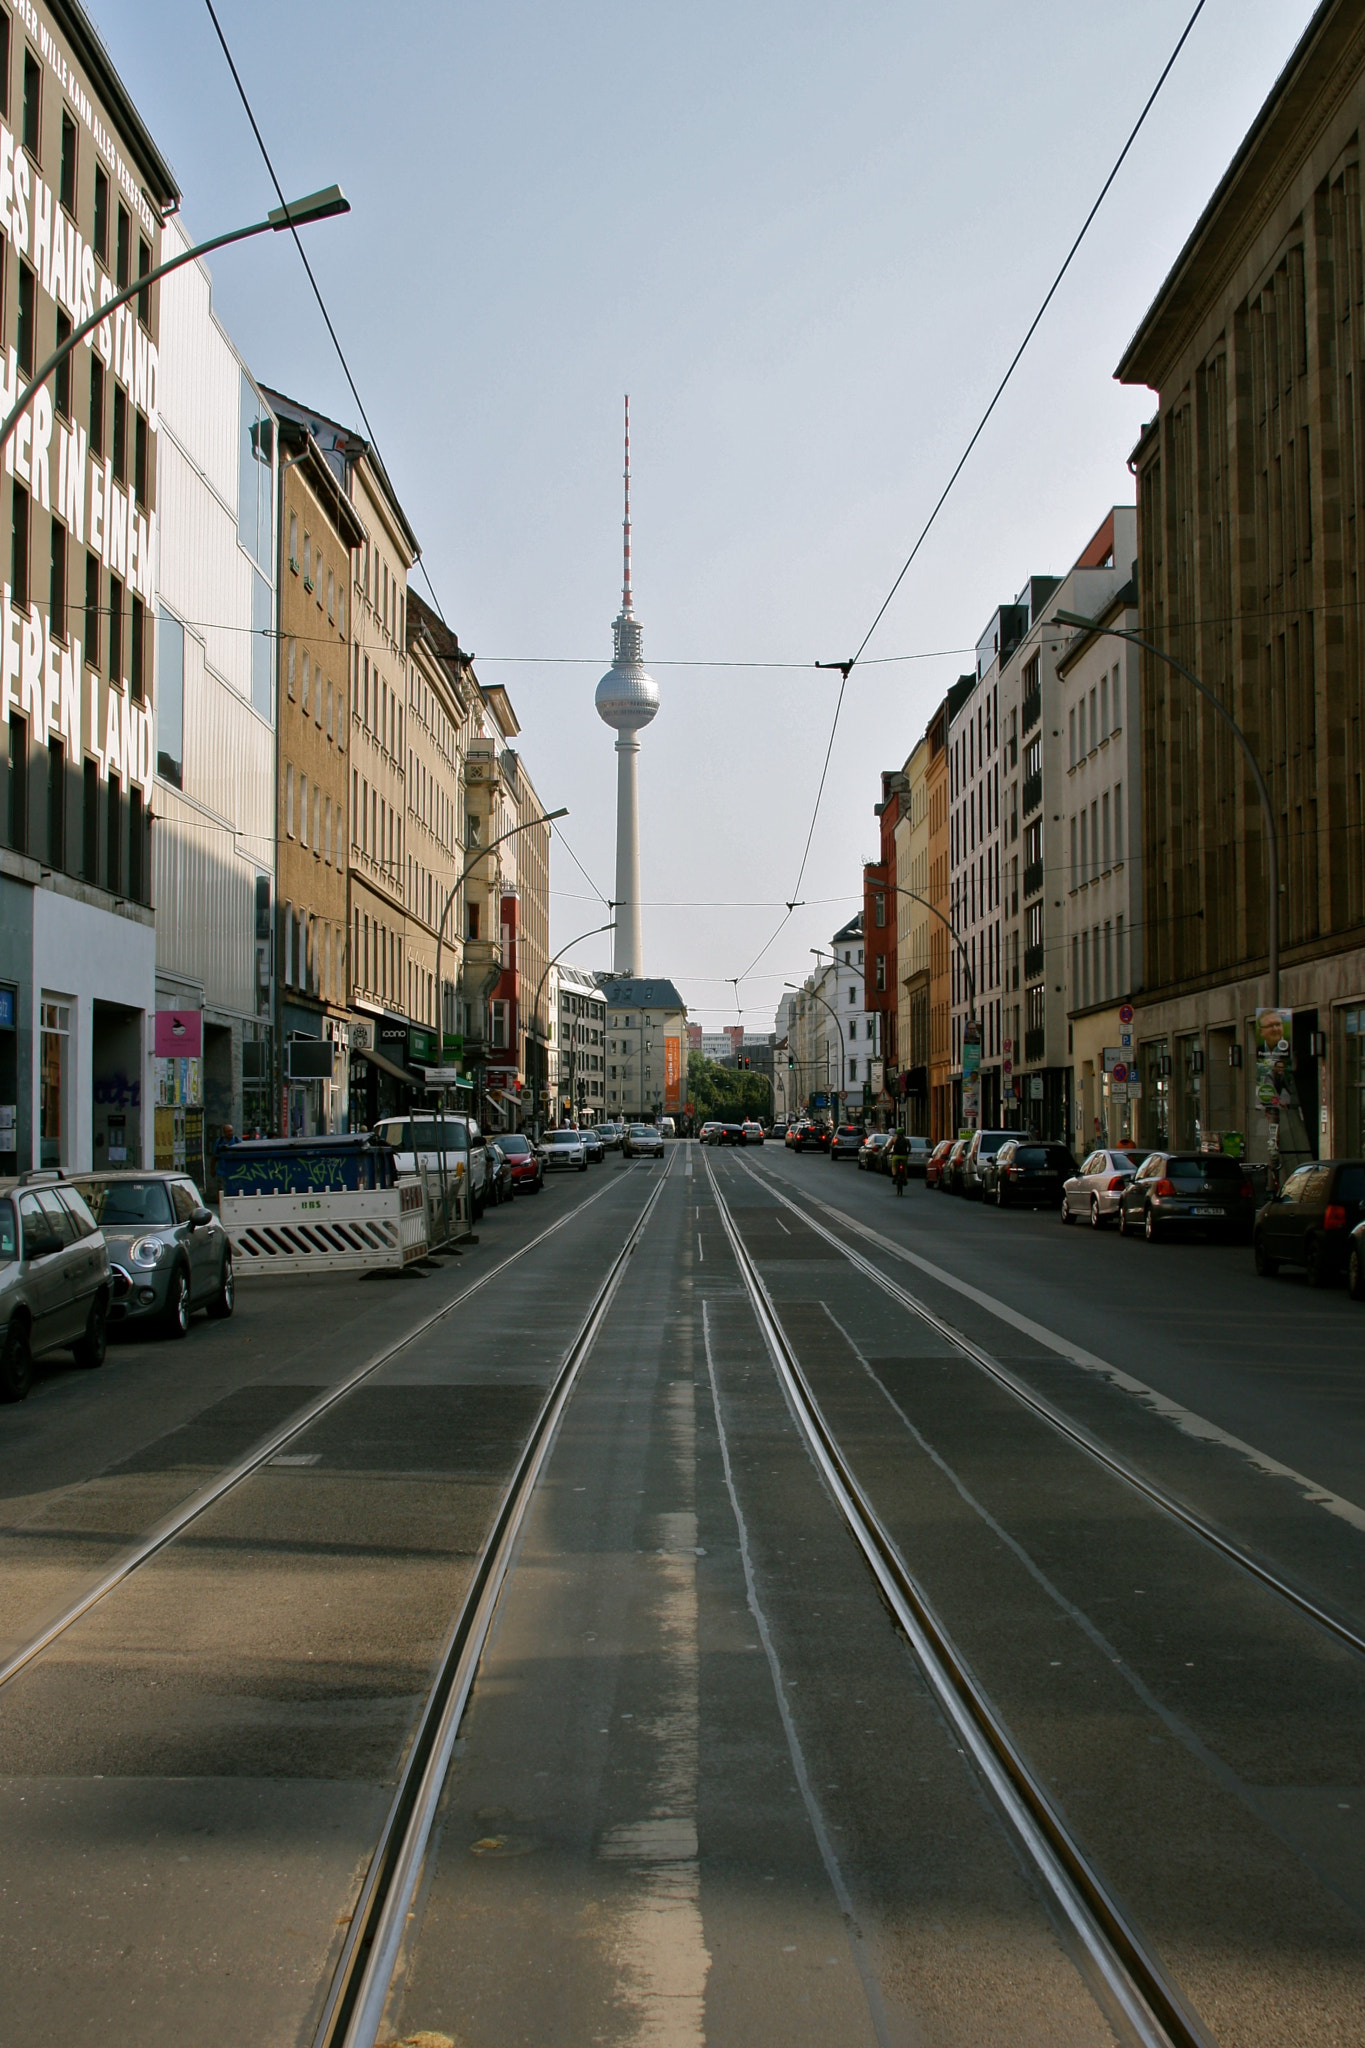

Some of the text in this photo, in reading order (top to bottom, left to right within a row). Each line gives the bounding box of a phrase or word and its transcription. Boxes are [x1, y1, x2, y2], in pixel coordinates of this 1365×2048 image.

[40, 21, 67, 89] WILLE
[68, 70, 93, 131] KANN
[93, 115, 117, 171] ALLES
[117, 156, 155, 239] VERSETZEN
[33, 173, 96, 348] HAUS
[99, 276, 160, 432] STAND
[57, 419, 87, 545] IN
[90, 456, 156, 615] EINEM
[90, 673, 154, 806] LAND
